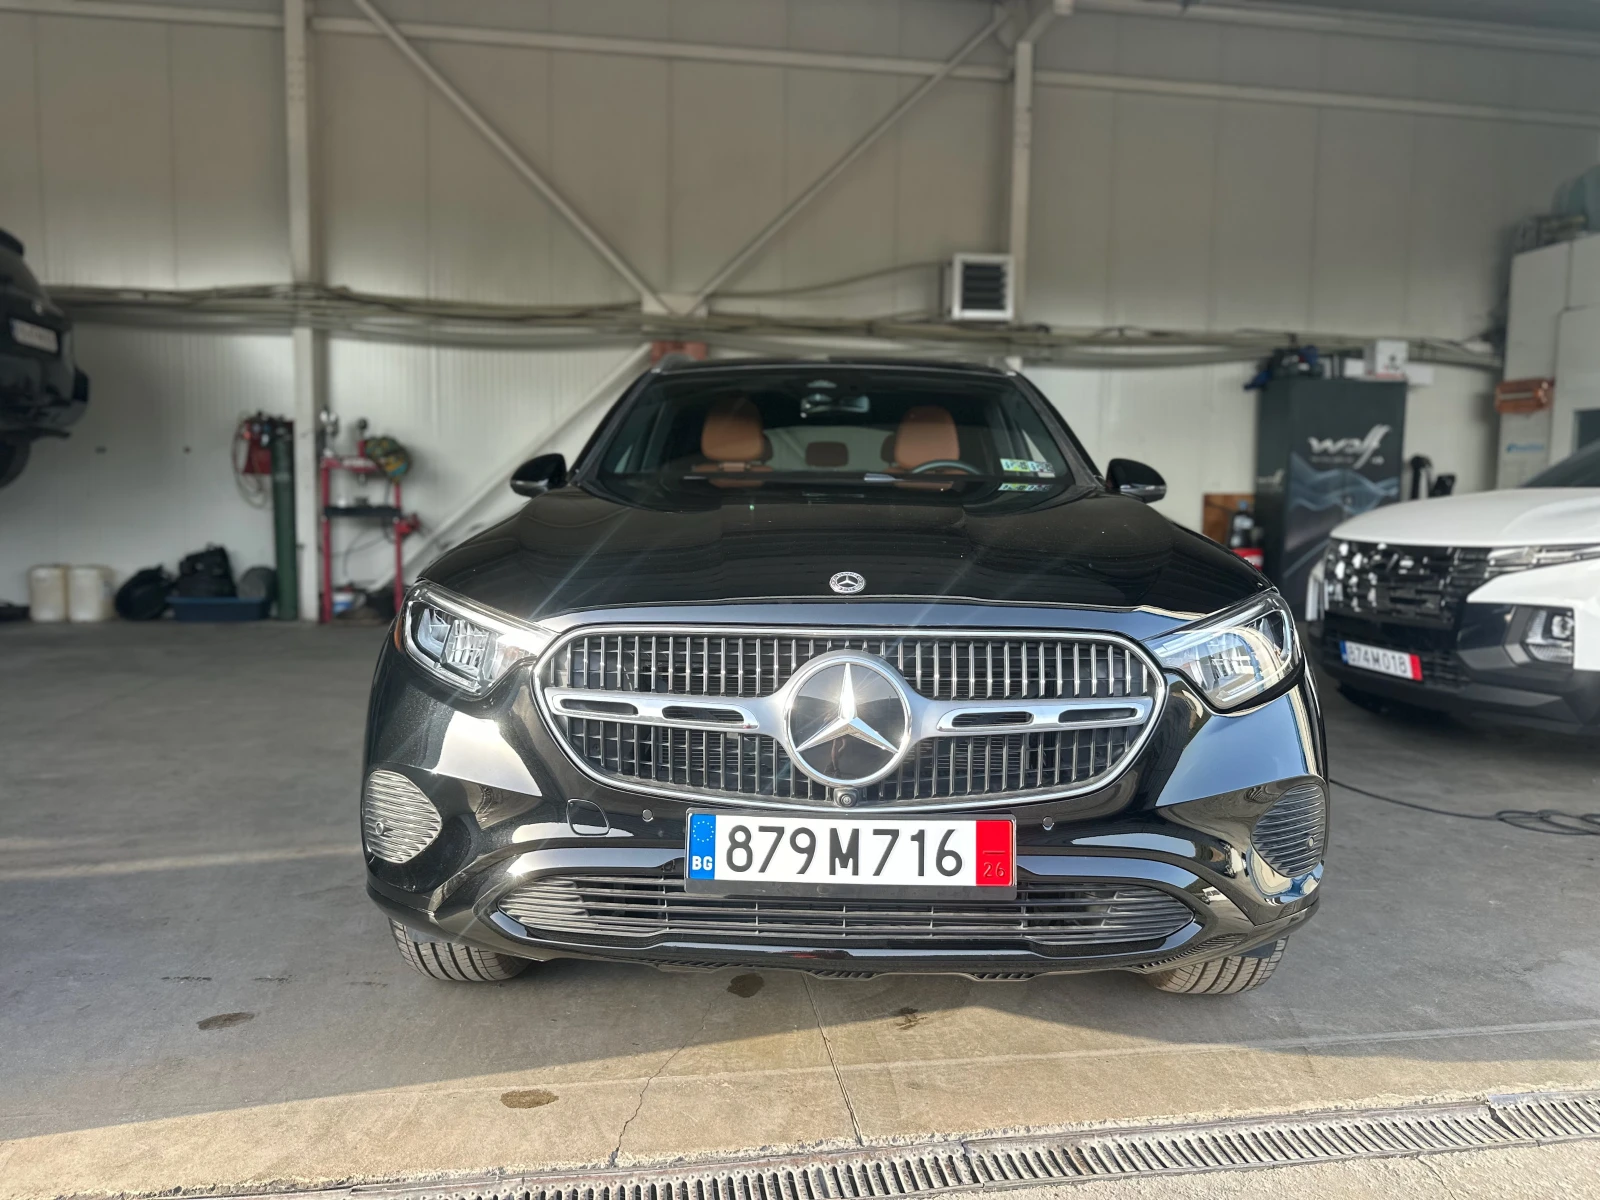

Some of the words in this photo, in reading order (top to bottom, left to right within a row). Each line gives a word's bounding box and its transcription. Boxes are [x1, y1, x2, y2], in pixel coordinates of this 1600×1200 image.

[725, 825, 964, 877] 879M716
[691, 855, 713, 871] BG
[982, 861, 1006, 878] 26
